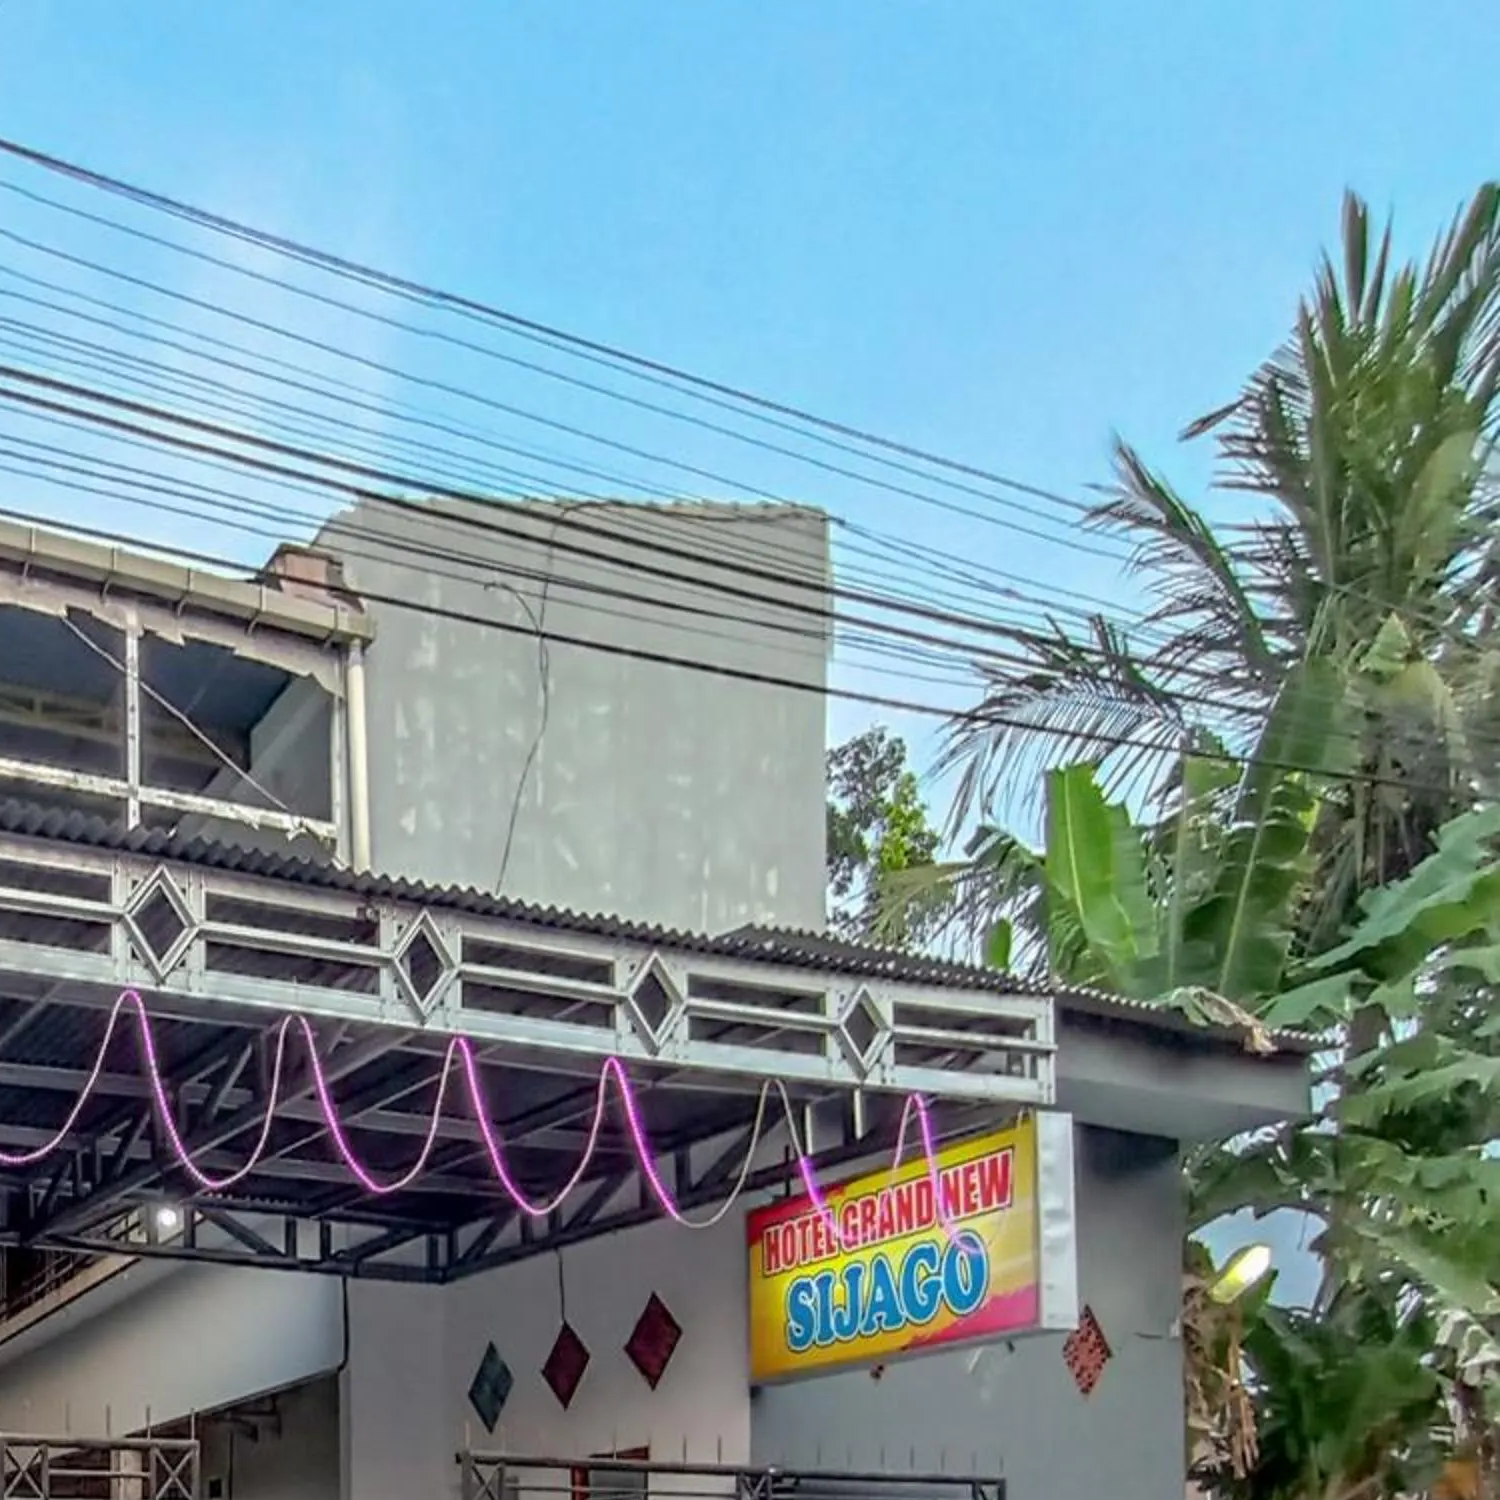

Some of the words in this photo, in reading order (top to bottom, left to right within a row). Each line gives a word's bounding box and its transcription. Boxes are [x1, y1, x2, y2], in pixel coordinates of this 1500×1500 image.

[764, 1210, 838, 1274] HOTEL
[840, 1177, 936, 1249] GRAND
[938, 1149, 1013, 1223] NEW
[787, 1231, 989, 1352] SIJAGO
